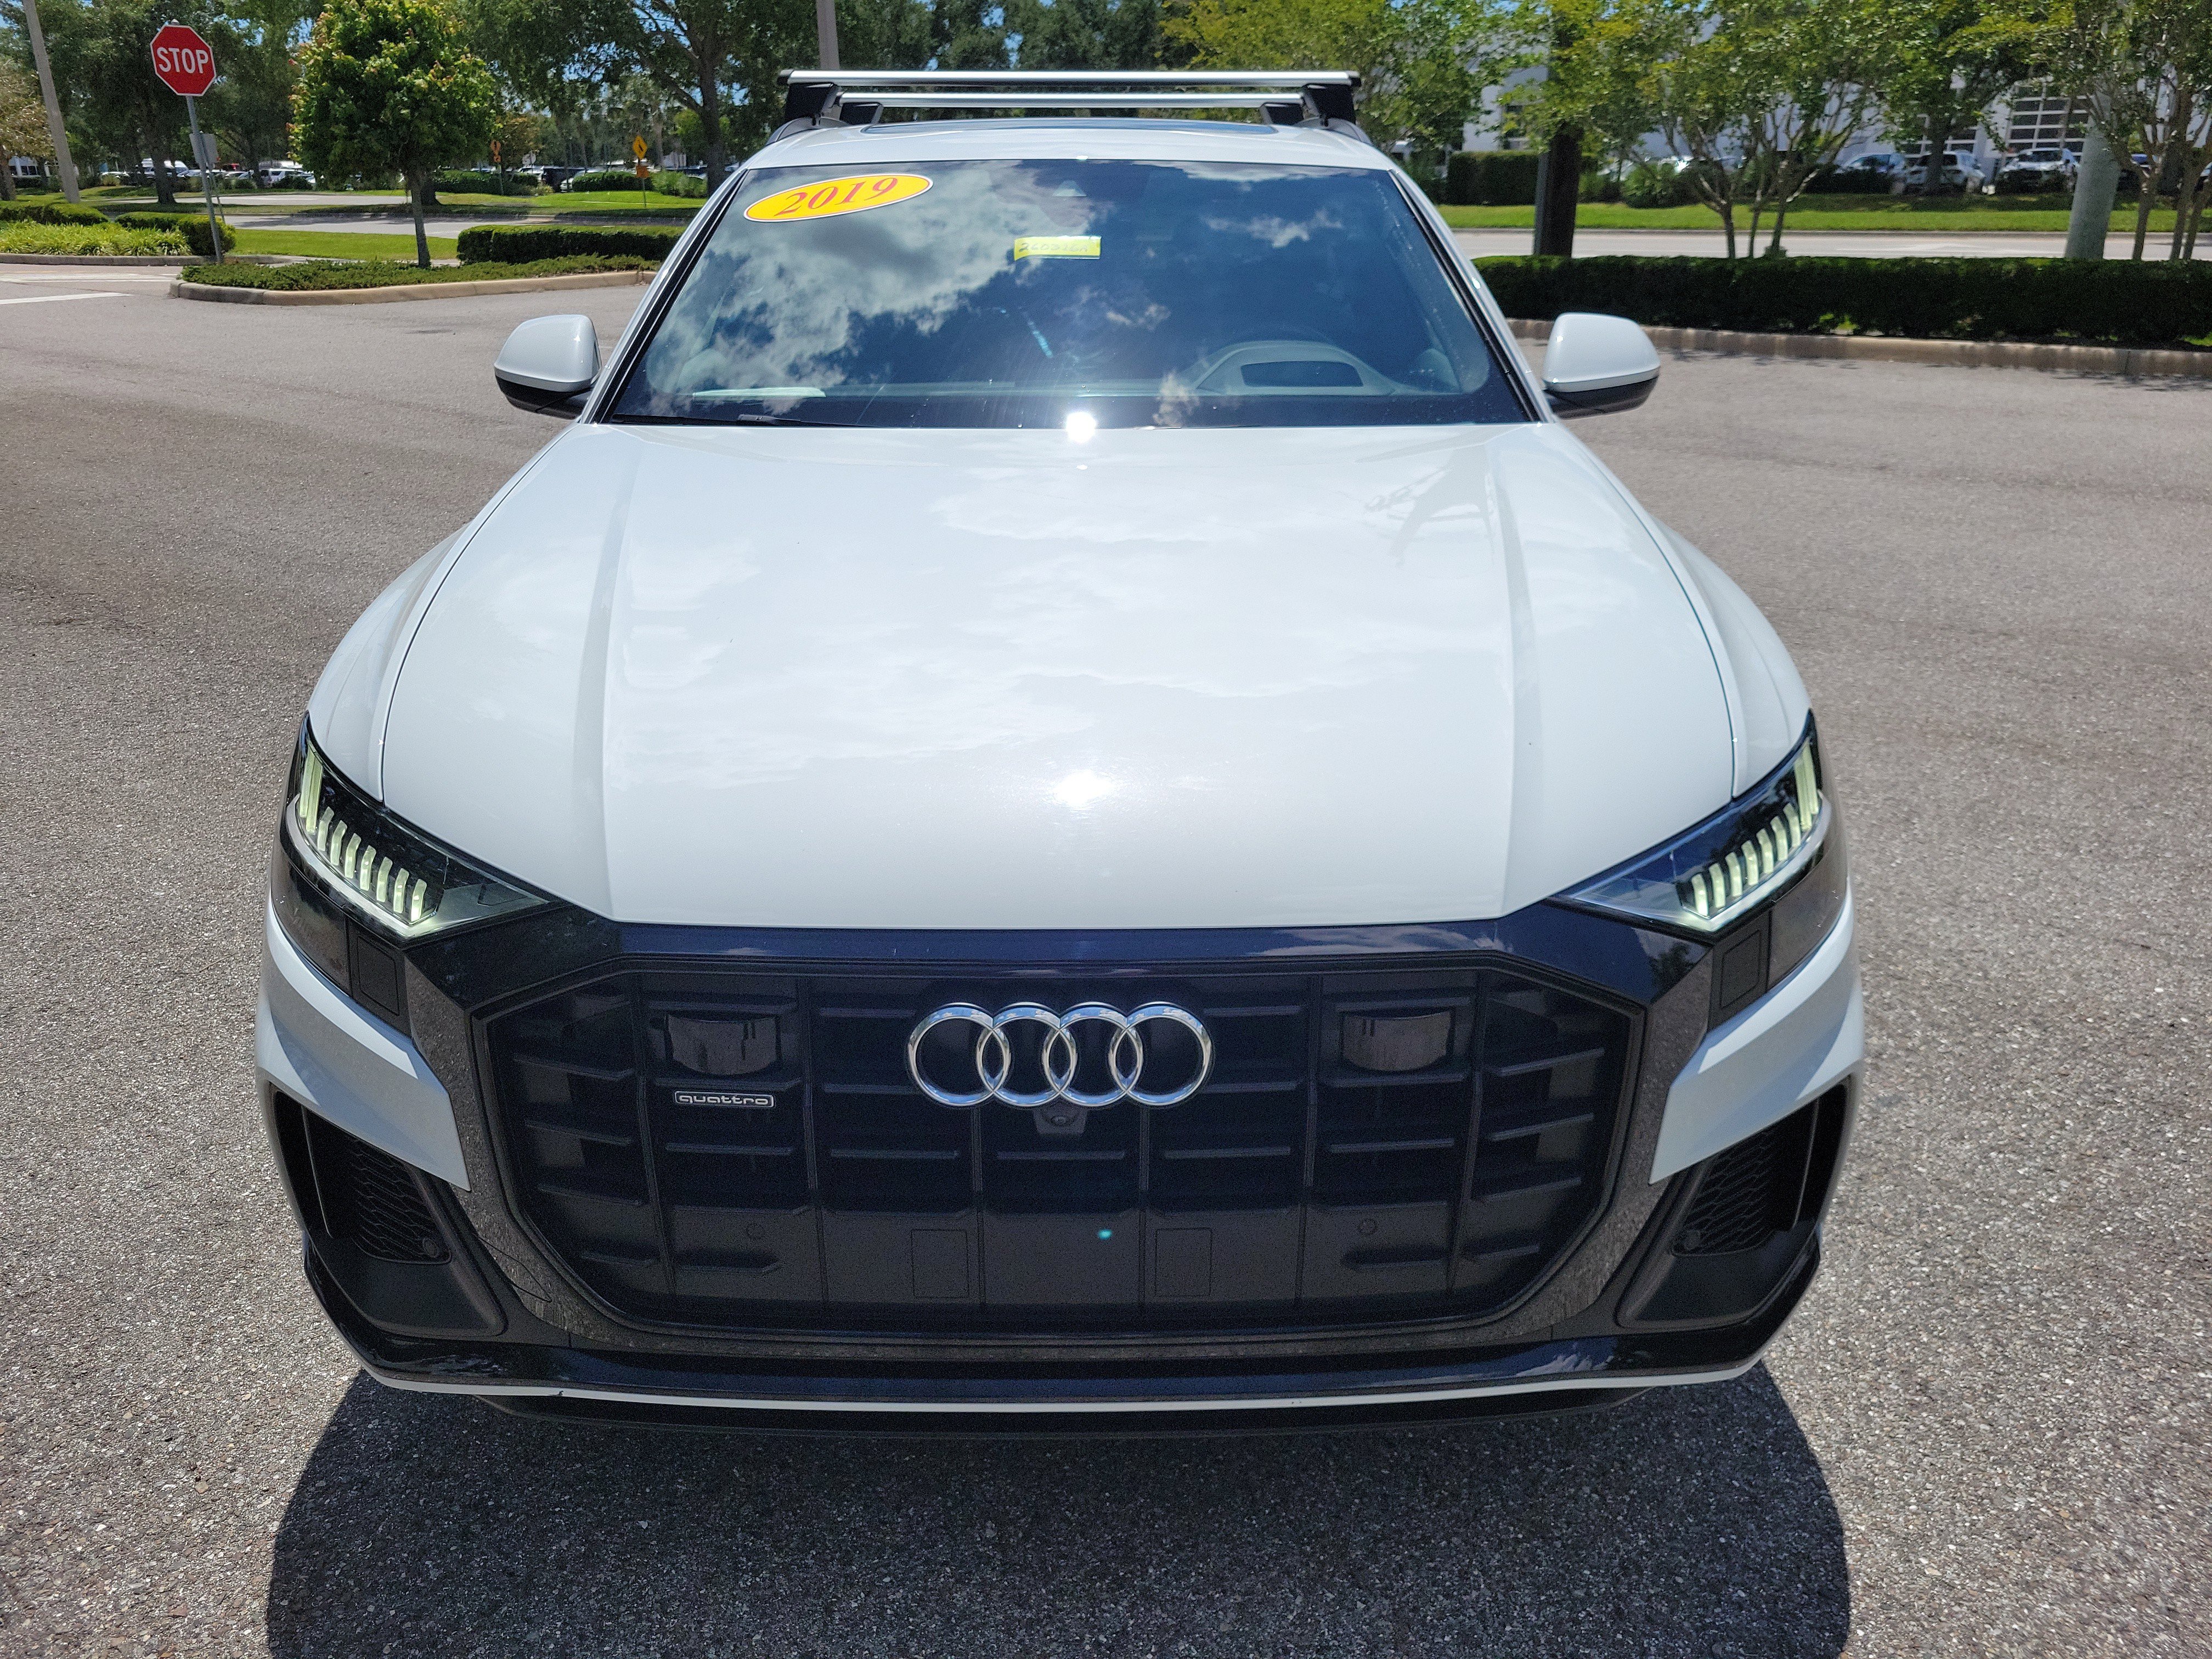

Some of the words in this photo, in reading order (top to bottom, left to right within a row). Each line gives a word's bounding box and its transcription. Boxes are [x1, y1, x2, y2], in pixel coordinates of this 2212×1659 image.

[157, 47, 208, 74] STOP
[774, 178, 898, 216] 2019
[679, 1095, 769, 1105] quattro
